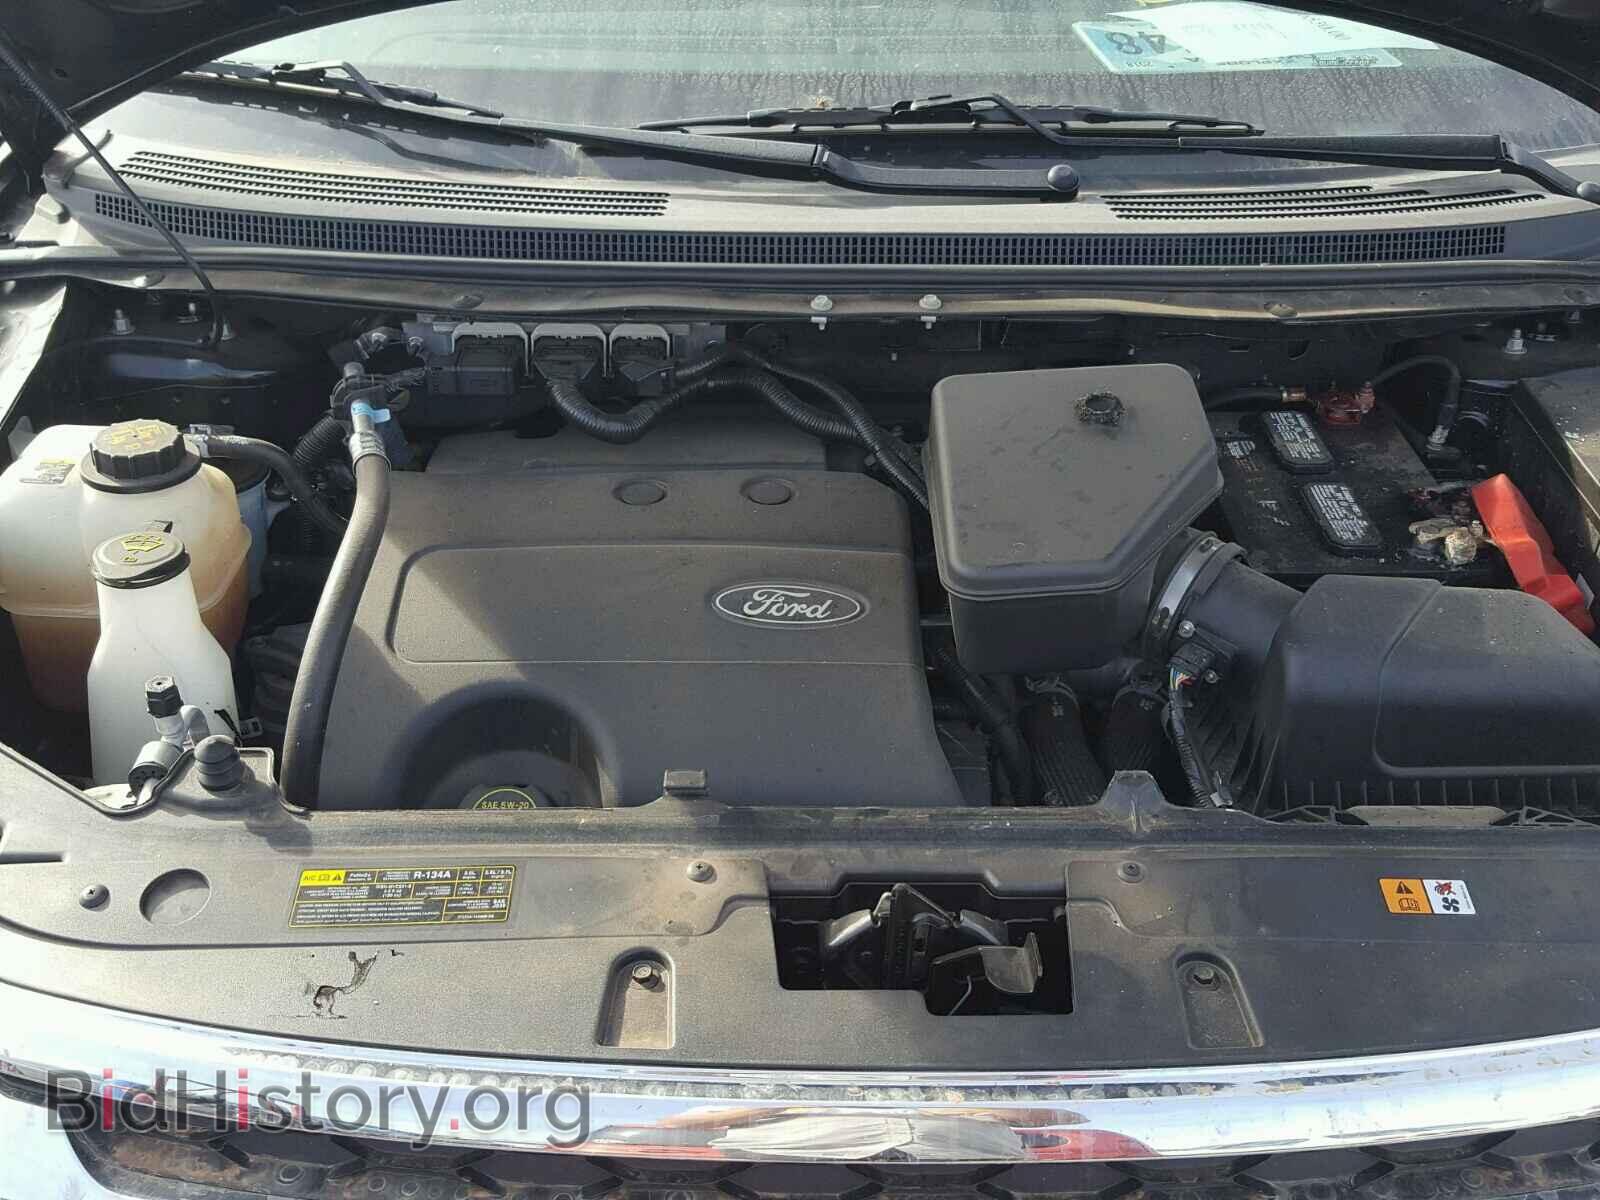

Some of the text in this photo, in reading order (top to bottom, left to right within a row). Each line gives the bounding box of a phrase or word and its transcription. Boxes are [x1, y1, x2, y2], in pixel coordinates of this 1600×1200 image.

[743, 589, 833, 618] Ford
[481, 801, 529, 809] SAE 5W-20
[413, 870, 451, 880] R-134A
